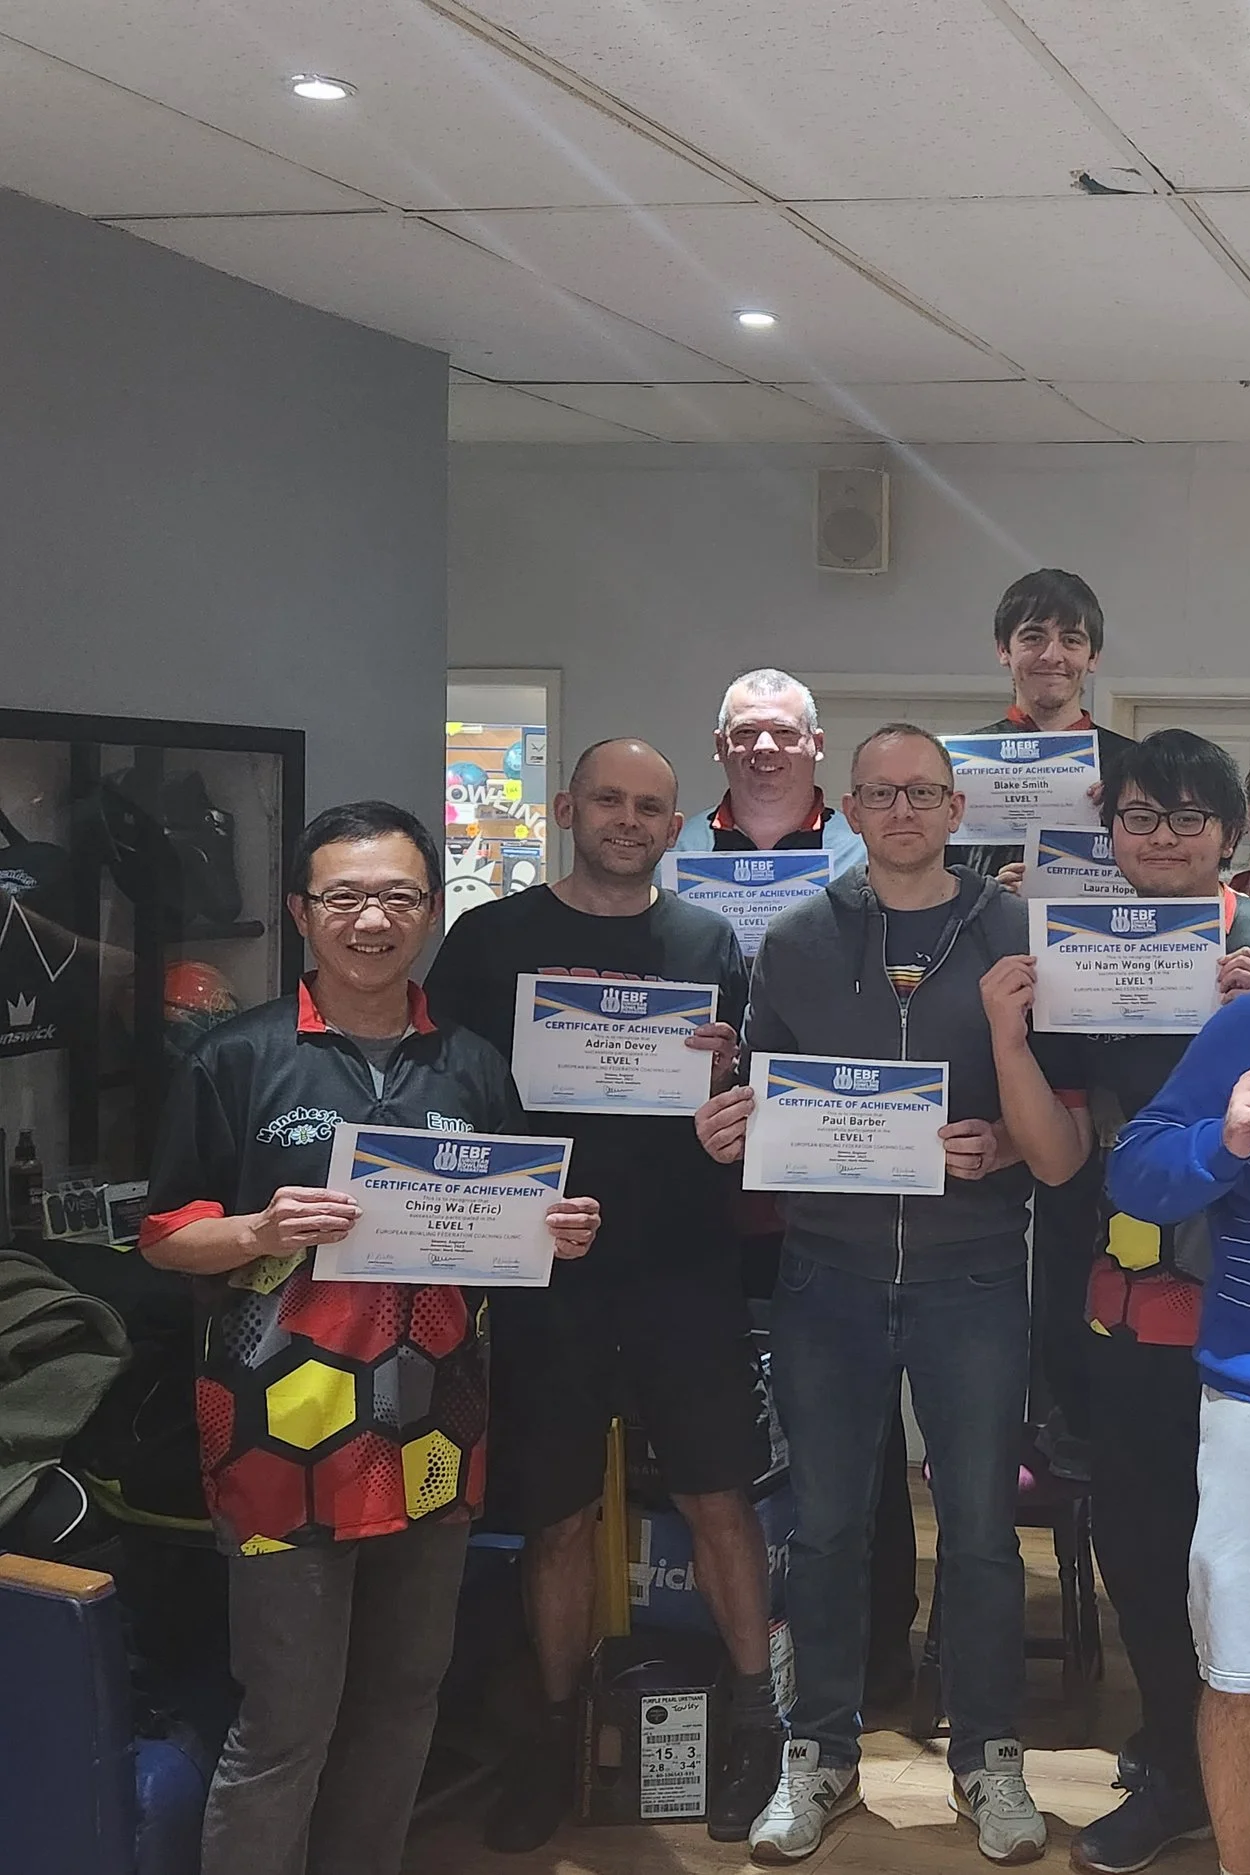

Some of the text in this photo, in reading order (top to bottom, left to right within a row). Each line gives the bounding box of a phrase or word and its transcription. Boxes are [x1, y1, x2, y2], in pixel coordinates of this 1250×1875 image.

[1017, 740, 1040, 749] EBF
[956, 766, 1085, 775] CERTIFICATE OF ACHIEVEMENT
[994, 780, 1049, 789] Blake Smith
[1005, 795, 1030, 803] LEVEL
[751, 860, 774, 871] EBF
[1046, 866, 1099, 877] CERTIFICATE
[1101, 868, 1113, 876] OF
[1083, 883, 1136, 895] Laura Hope
[688, 891, 744, 899] CERTIFICATE
[721, 905, 745, 914] Greg
[1130, 909, 1157, 921] EBF
[738, 918, 766, 926] LEVEL
[1059, 943, 1209, 954] CERTIFICATE OF ACHIEVEMENT
[1075, 959, 1193, 971] Yui Nam Wong (Kurtis)
[1115, 977, 1154, 986] LEVEL 1
[621, 991, 648, 1003] EBF
[545, 1021, 696, 1036] CERTIFICATE OF ACHIEVEMENT
[585, 1039, 657, 1052] Adrian Devey
[600, 1056, 640, 1065] LEVEL 1
[853, 1069, 880, 1080] EBF
[778, 1097, 931, 1112] CERTIFICATE OF ACHIEVEMENT
[256, 1106, 348, 1142] Mancheste
[822, 1115, 887, 1127] Paul Barber
[833, 1133, 873, 1142] LEVEL 1
[460, 1145, 492, 1160] EBF
[364, 1179, 545, 1198] CERTIFICATE OF ACHIEVEMENT
[67, 1199, 97, 1212] VISE
[405, 1200, 502, 1216] Ching Wa (Eric)
[428, 1220, 474, 1231] LEVEL 1
[655, 1746, 696, 1760] 15 3
[649, 1763, 665, 1772] 2.8
